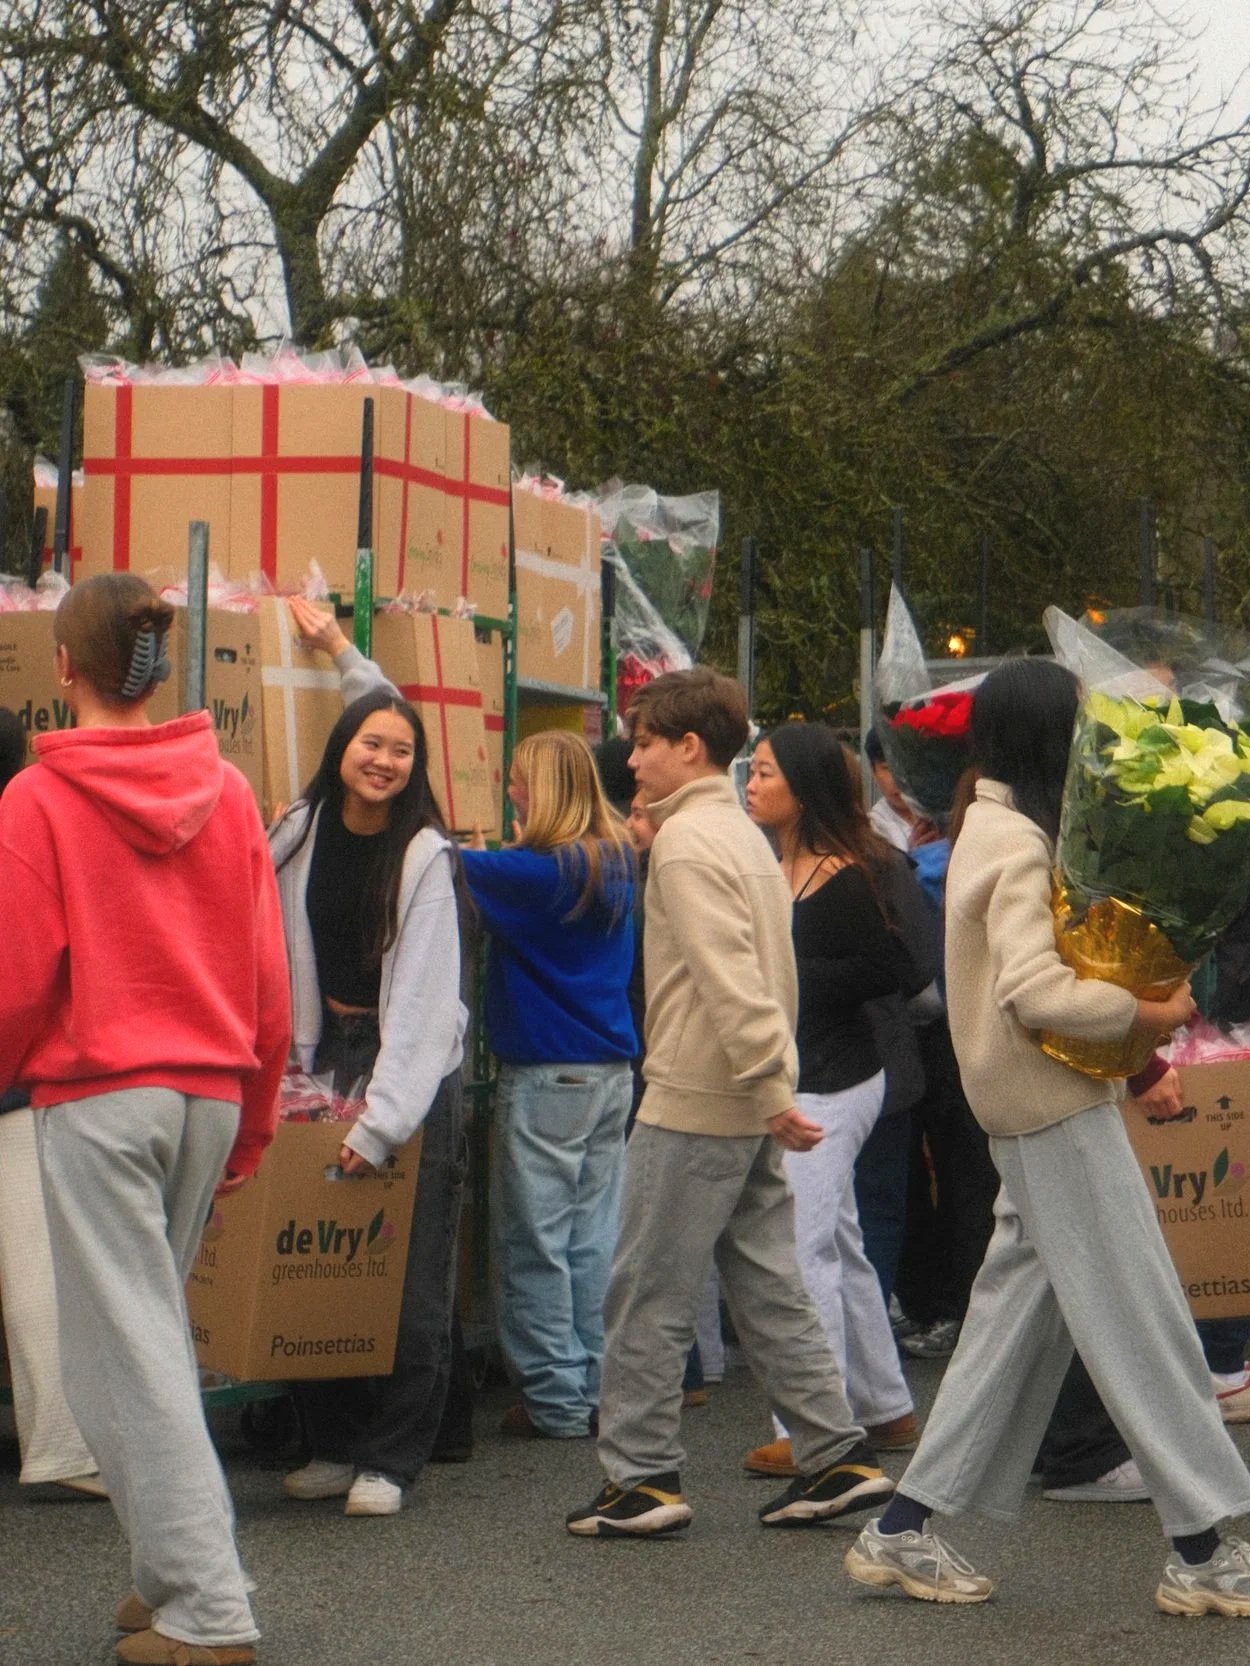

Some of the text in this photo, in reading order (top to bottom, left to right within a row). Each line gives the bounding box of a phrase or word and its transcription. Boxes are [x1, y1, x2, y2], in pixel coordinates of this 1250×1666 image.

[18, 698, 78, 732] deVr
[212, 698, 240, 740] Vry
[1205, 1110, 1246, 1122] THIS SIDE
[1219, 1121, 1232, 1131] UP
[1150, 1163, 1208, 1205] Vry
[1156, 1198, 1249, 1225] houses ltd.
[271, 1255, 389, 1287] greenhouses ltd.
[269, 1333, 376, 1359] Poinsettias
